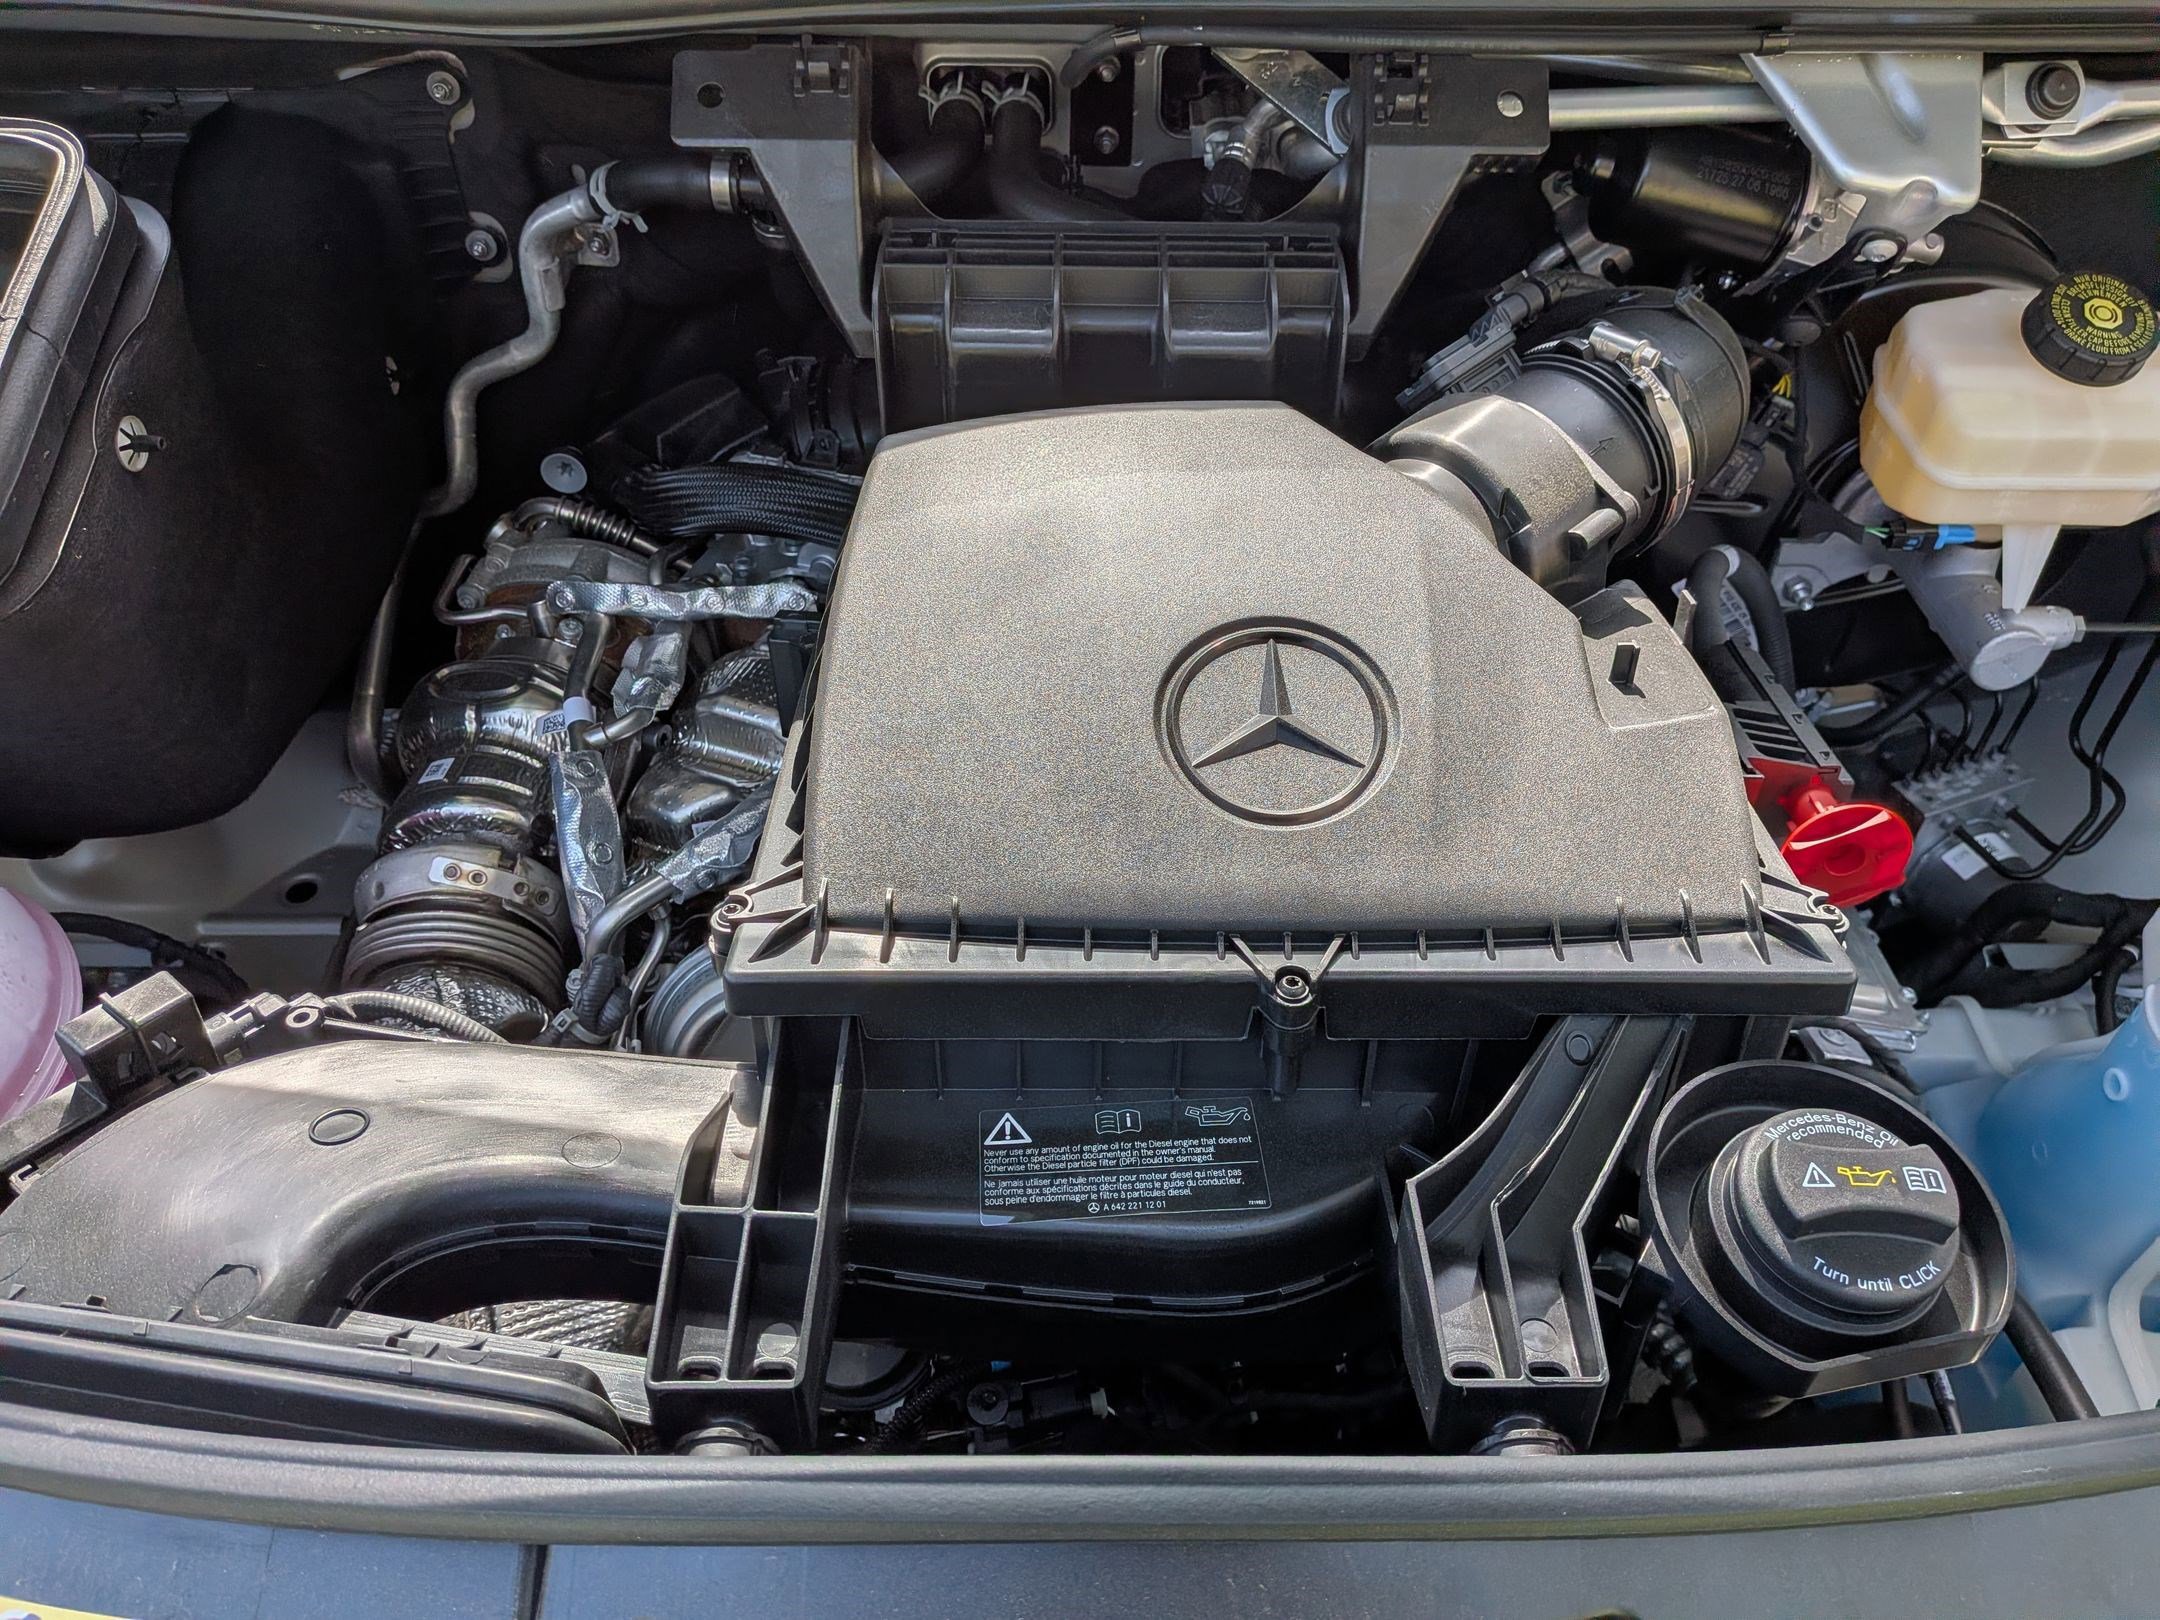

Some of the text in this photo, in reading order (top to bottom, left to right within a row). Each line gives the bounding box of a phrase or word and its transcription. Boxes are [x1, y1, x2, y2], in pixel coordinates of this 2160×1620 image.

[2074, 274, 2129, 292] NUR ORIGINAL
[2077, 289, 2128, 308] VERWENDEN
[2065, 318, 2088, 338] FILLER
[2088, 335, 2103, 344] CAP
[2104, 336, 2132, 347] BEFORE
[2086, 326, 2122, 338] WARNING
[2063, 329, 2087, 346] BRAKE
[2086, 343, 2109, 354] FLUID
[2109, 346, 2130, 355] FROM
[1764, 1112, 1899, 1146] Mercedes-Benz Oil
[1786, 1124, 1885, 1149] recommended
[984, 1149, 1007, 1157] Never
[1025, 1148, 1040, 1156] any
[1041, 1146, 1070, 1154] amount
[1072, 1144, 1081, 1152] of
[1082, 1142, 1108, 1152] engine
[1110, 1142, 1120, 1150] oil
[1121, 1141, 1132, 1149] for
[1134, 1140, 1148, 1149] the
[1148, 1139, 1173, 1148] Diesel
[1173, 1138, 1199, 1148] engine
[1200, 1137, 1217, 1146] that
[1218, 1136, 1237, 1144] does
[1238, 1135, 1252, 1143] not
[984, 1157, 1017, 1165] conform
[1030, 1152, 1080, 1162] specification
[1082, 1150, 1131, 1160] documented
[1132, 1149, 1140, 1157] in
[1141, 1148, 1154, 1156] the
[1155, 1147, 1187, 1156] owner's
[984, 1164, 1025, 1173] Otherwise
[1042, 1161, 1066, 1170] Diesel
[1067, 1159, 1097, 1170] particle
[1099, 1157, 1118, 1166] filter
[1119, 1157, 1140, 1168] (DPF)
[1141, 1155, 1163, 1165] could
[1164, 1155, 1174, 1163] be
[1175, 1154, 1214, 1163] damaged.
[984, 1169, 1242, 1189] Ne jamais utiliser une huile moteur pour moteur diesel qui n'est pas
[984, 1187, 1024, 1196] conforme
[1042, 1184, 1097, 1194] spécifications
[1099, 1181, 1132, 1191] décrites
[1133, 1181, 1153, 1190] dans
[1154, 1180, 1162, 1189] le
[1163, 1179, 1185, 1189] guide
[1186, 1178, 1197, 1186] du
[984, 1188, 1193, 1206] sous peine d'endommager le filtre à particules diesel.
[1103, 1200, 1167, 1211] A 642 221 12 01
[1813, 1255, 1942, 1292] Turn until CLICK
